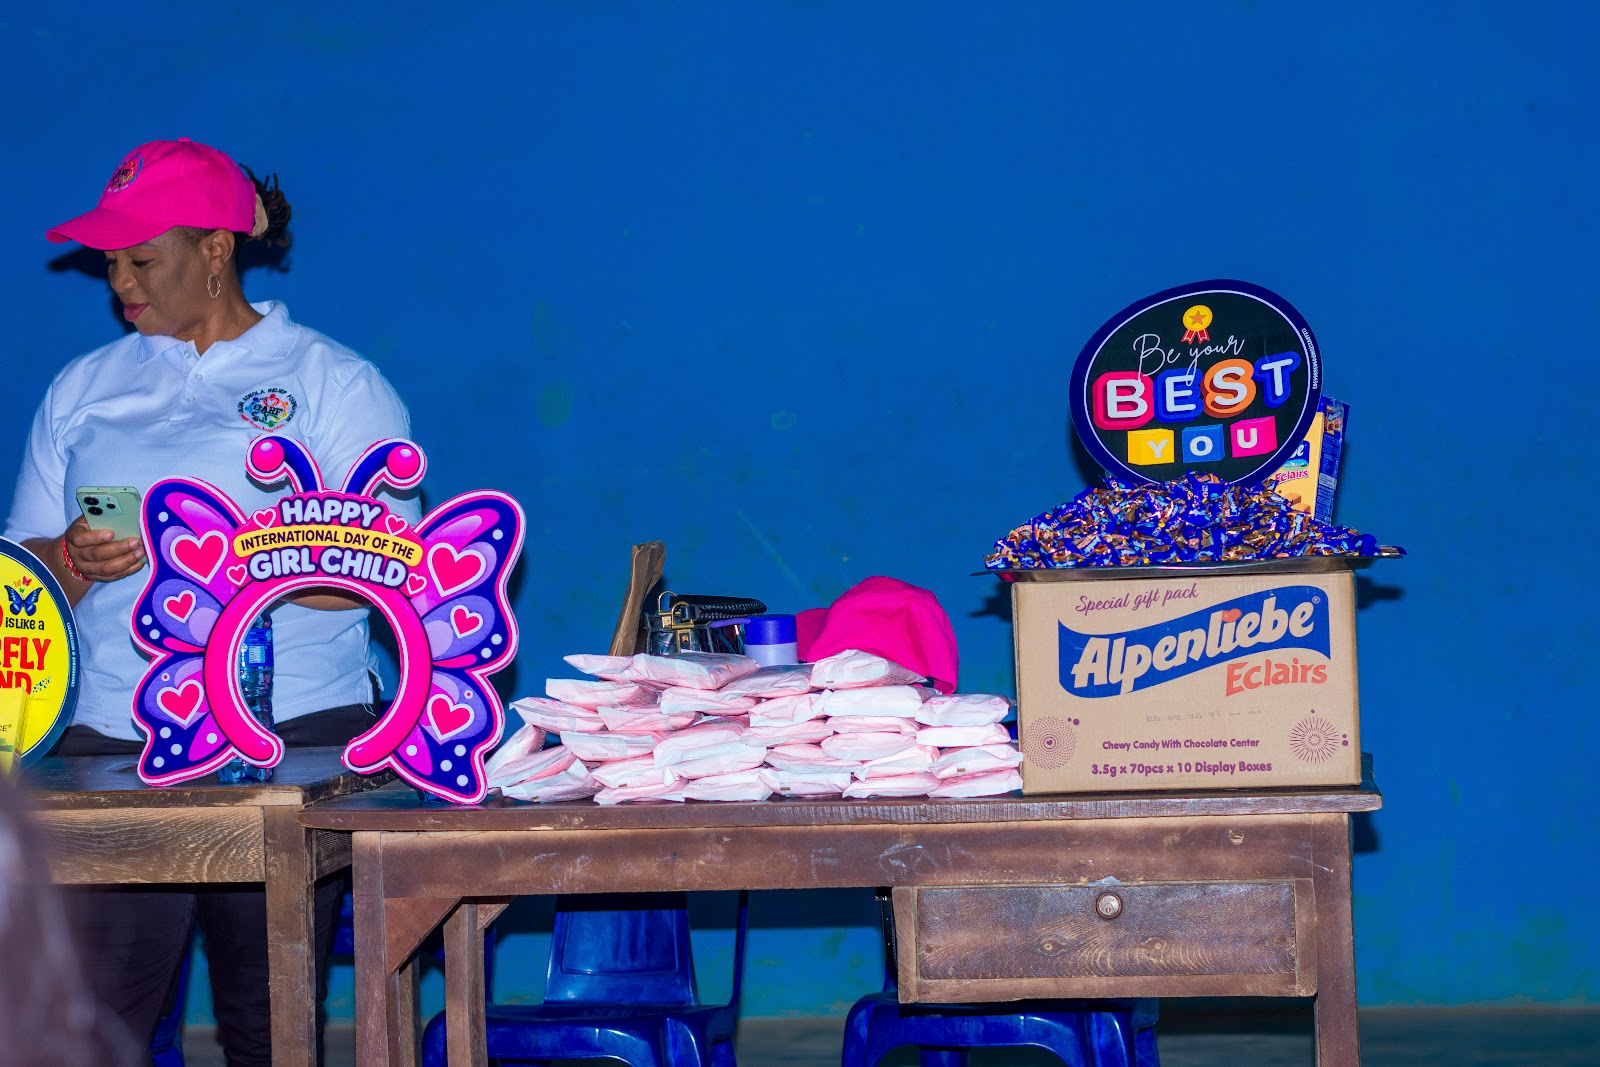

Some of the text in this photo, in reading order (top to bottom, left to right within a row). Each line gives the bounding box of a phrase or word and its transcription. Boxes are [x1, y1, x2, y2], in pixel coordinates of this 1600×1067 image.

[1133, 333, 1181, 381] Be
[1185, 334, 1245, 387] your
[1106, 358, 1294, 419] BEST
[1147, 427, 1258, 459] YOU
[1275, 469, 1309, 483] Eclairs
[281, 499, 382, 528] HAPPY
[240, 529, 415, 560] INTERNATIONAL DAY OF THE
[249, 547, 407, 587] GIRL CHILD
[1075, 583, 1199, 616] Special gift pack
[0, 637, 52, 671] FLY
[1224, 657, 1328, 697] Eclairs
[1102, 738, 1260, 751] Chewy Candy With Chocolate Center
[1091, 760, 1272, 777] 3.5g x 70pcs x 10 Display Boxes
